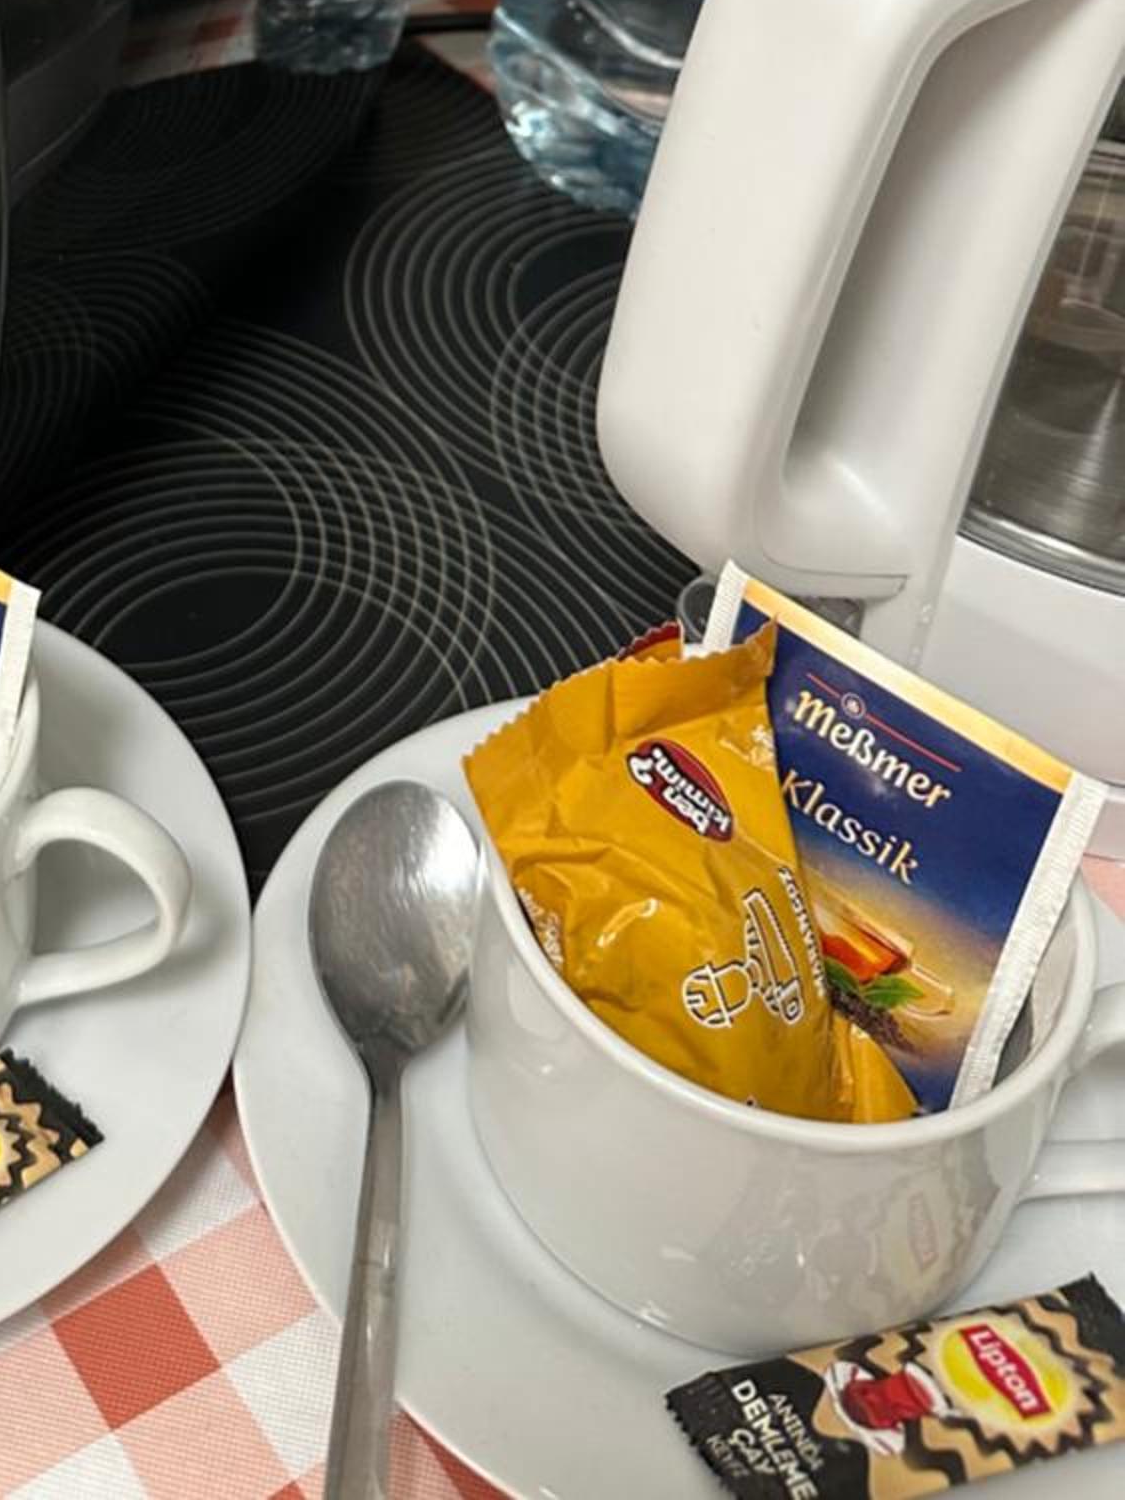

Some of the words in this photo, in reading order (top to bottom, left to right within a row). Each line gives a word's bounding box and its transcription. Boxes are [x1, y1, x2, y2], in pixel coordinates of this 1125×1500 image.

[794, 690, 952, 808] Meßmer
[663, 786, 710, 833] ben
[781, 768, 919, 886] Klassik
[969, 1329, 1039, 1412] Lipton
[728, 1428, 777, 1475] ÇAY
[731, 1379, 819, 1500] DEMLEME
